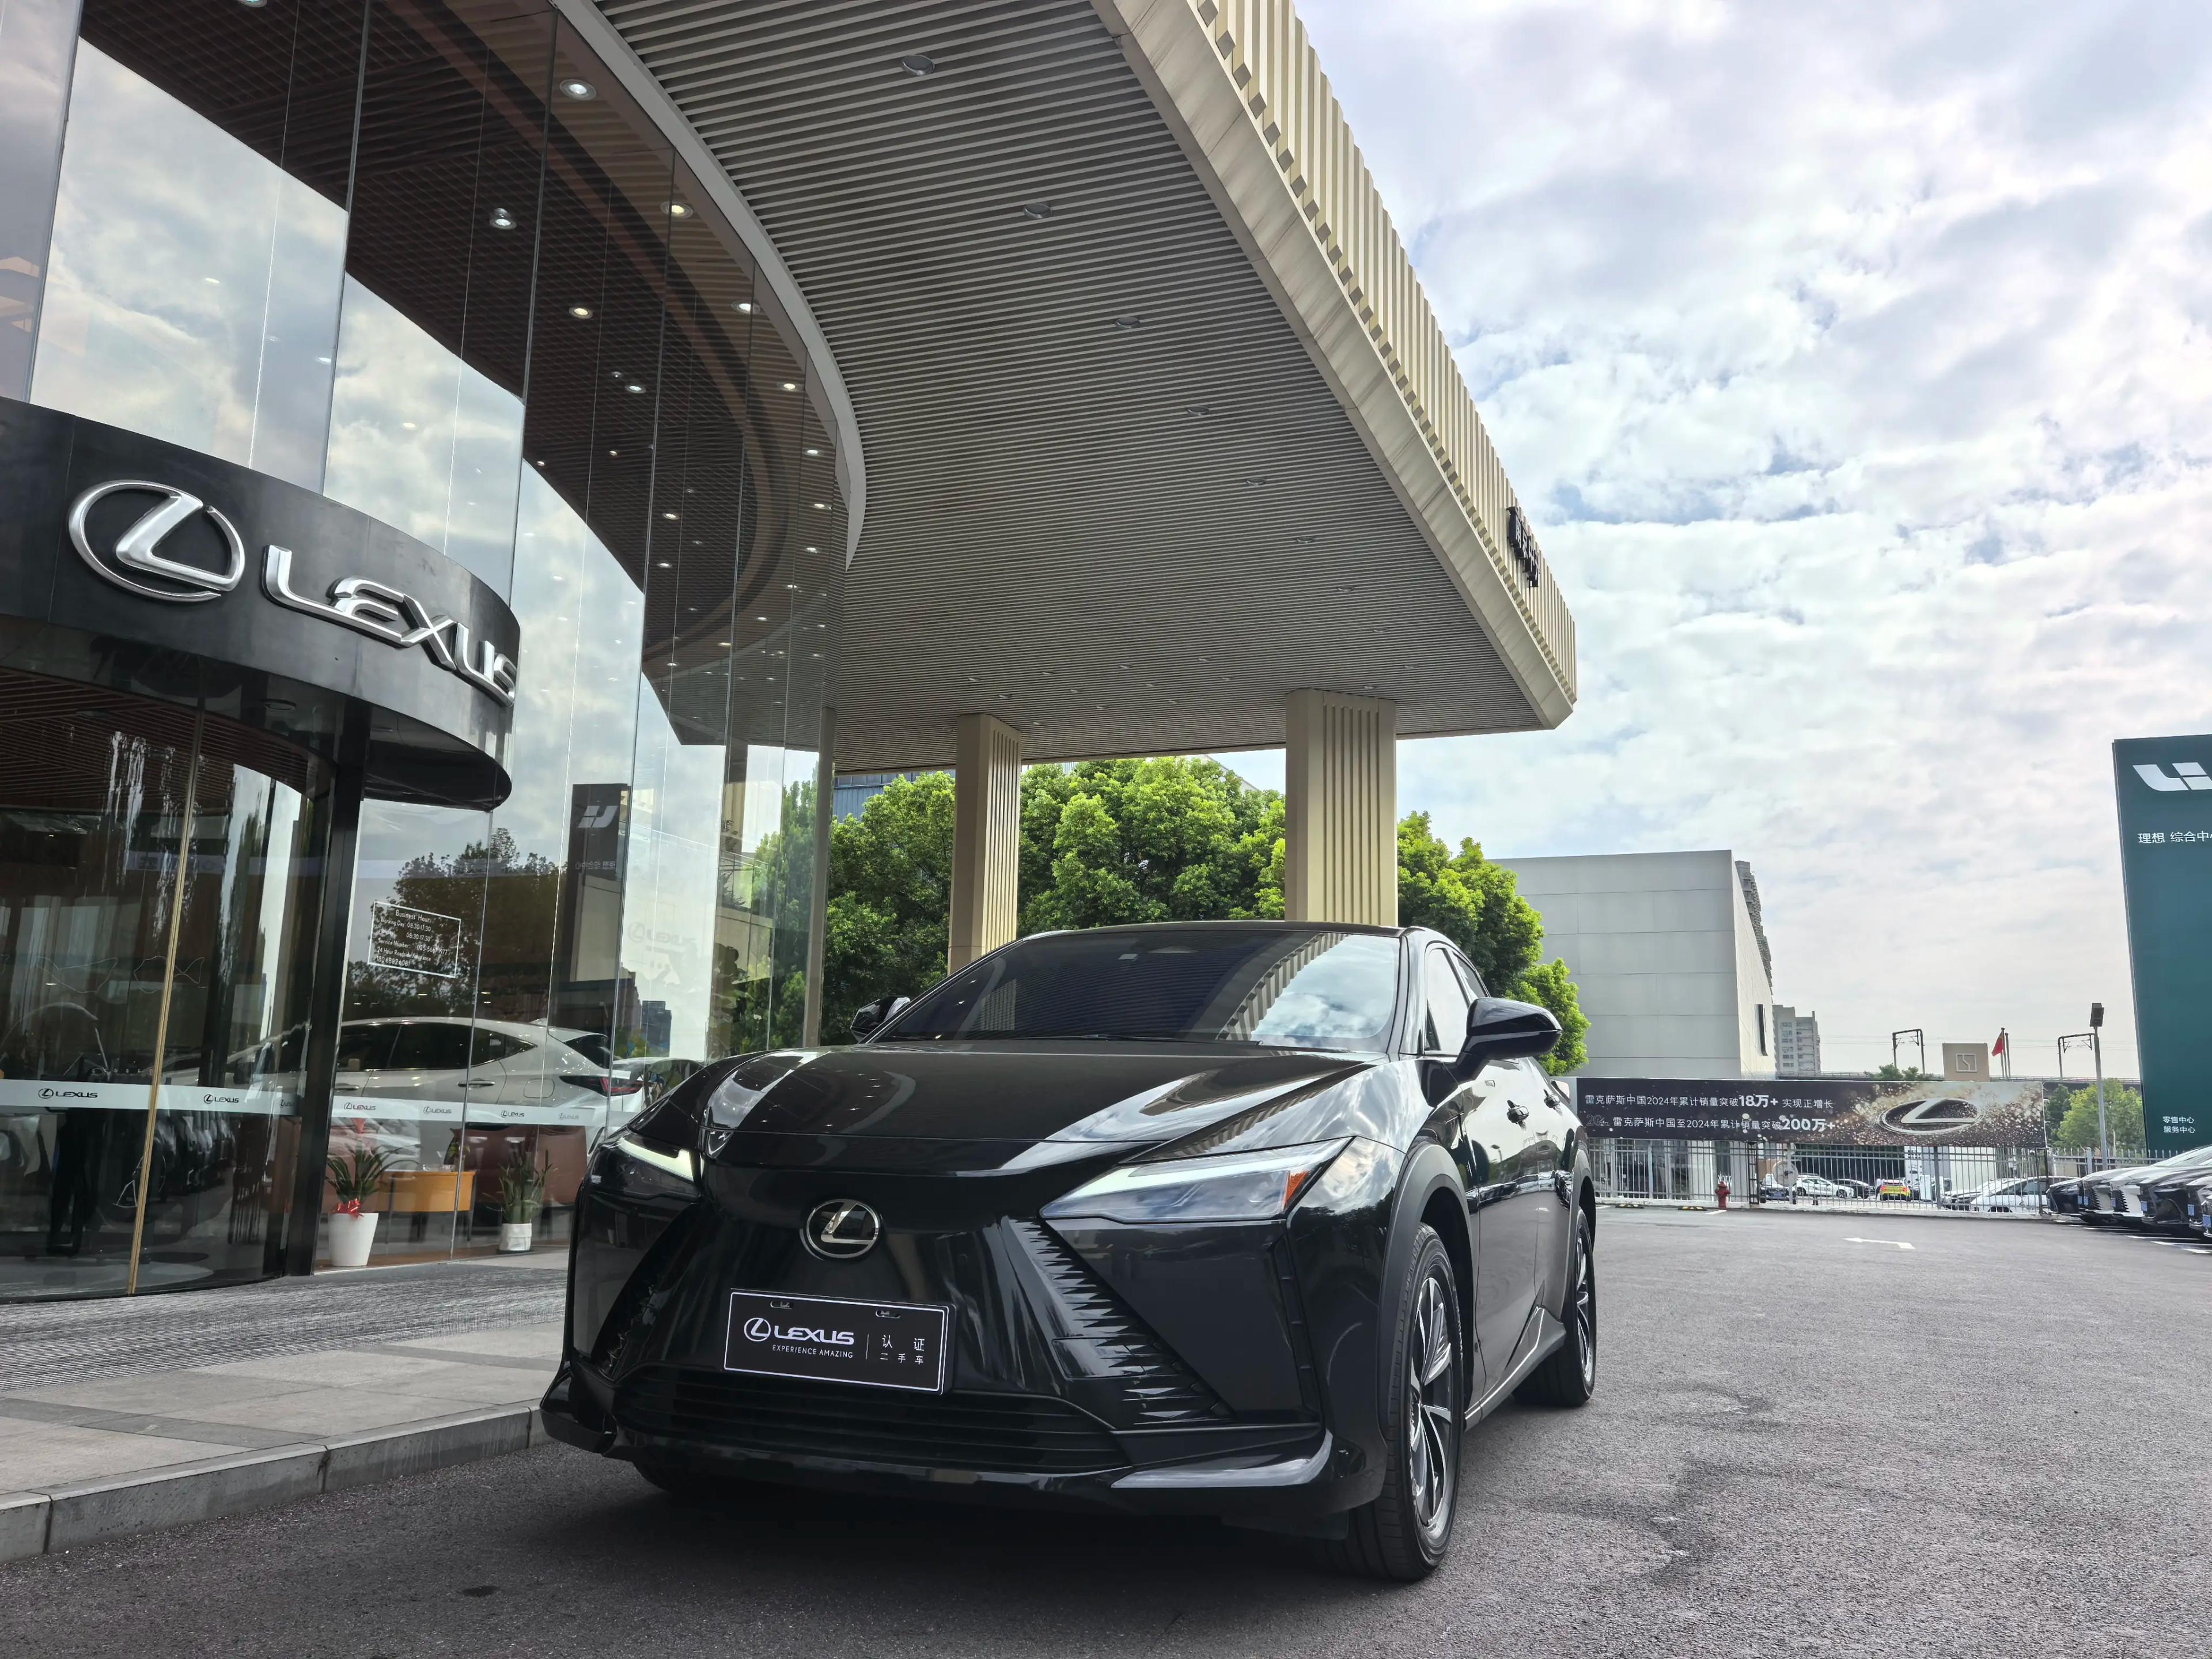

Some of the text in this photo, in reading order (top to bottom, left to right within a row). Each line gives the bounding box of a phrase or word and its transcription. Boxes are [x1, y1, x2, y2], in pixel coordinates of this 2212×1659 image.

[262, 544, 517, 708] LEXUS
[2138, 830, 2212, 844] 理想 综合中
[395, 909, 416, 920] Business
[1585, 1094, 1834, 1109] 雷克萨斯中国2024年累计销量突破18万+ 实现正增长
[1613, 1116, 1836, 1132] 雷克萨斯中国至2024年累计销量突破200万+
[2163, 1126, 2196, 1134] 服务中心
[774, 1325, 855, 1345] LEXUS
[772, 1344, 853, 1359] EXPERIENCE AMAZING
